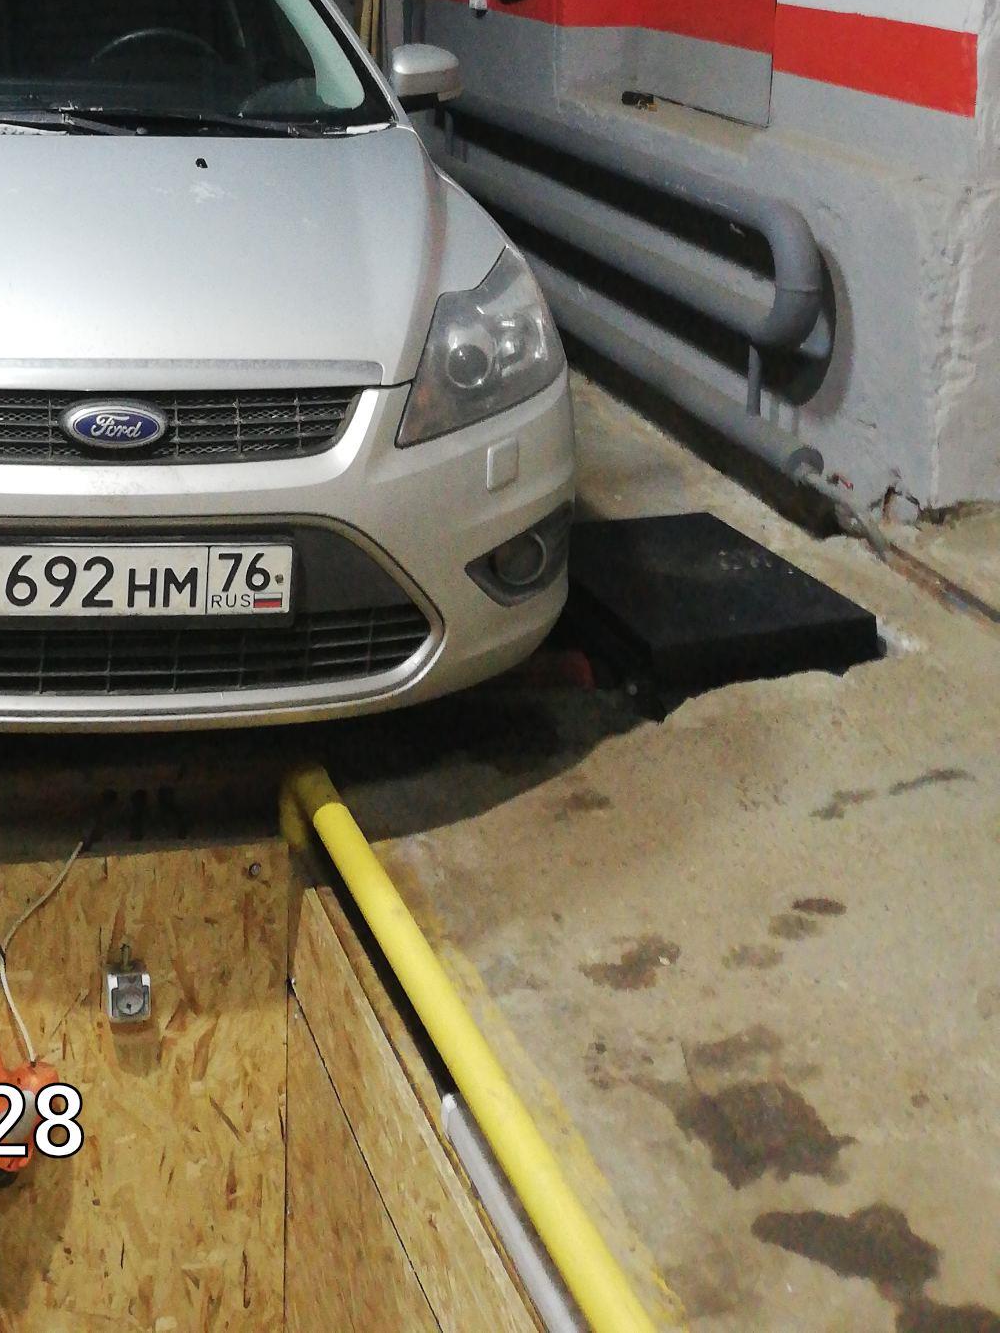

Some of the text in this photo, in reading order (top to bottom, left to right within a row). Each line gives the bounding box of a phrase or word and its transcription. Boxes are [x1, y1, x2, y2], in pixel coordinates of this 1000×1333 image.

[90, 413, 142, 438] Ford
[218, 552, 271, 593] 76
[210, 593, 251, 608] RUS
